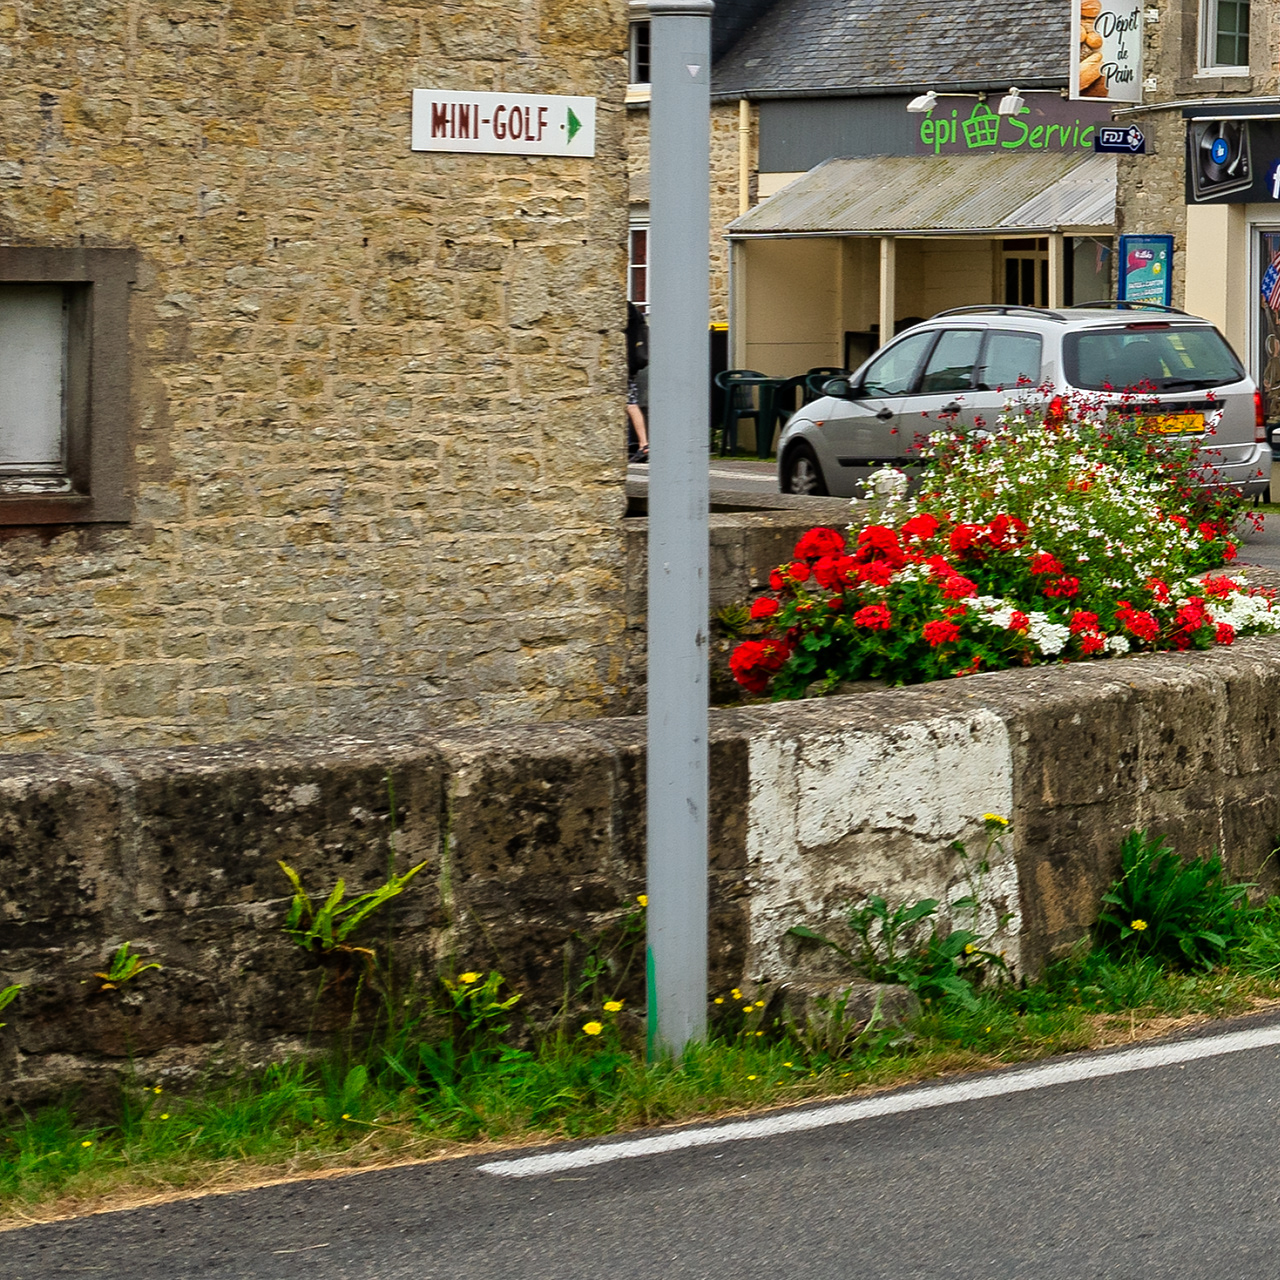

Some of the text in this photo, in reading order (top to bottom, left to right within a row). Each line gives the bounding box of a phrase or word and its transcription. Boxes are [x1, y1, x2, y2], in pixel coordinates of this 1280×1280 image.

[1094, 6, 1141, 44] Dépôt
[1116, 41, 1129, 61] de
[1099, 63, 1135, 89] Pain
[430, 102, 549, 142] MINI-GOLF
[920, 106, 1095, 154] épi Servic
[1102, 130, 1124, 144] FDJ
